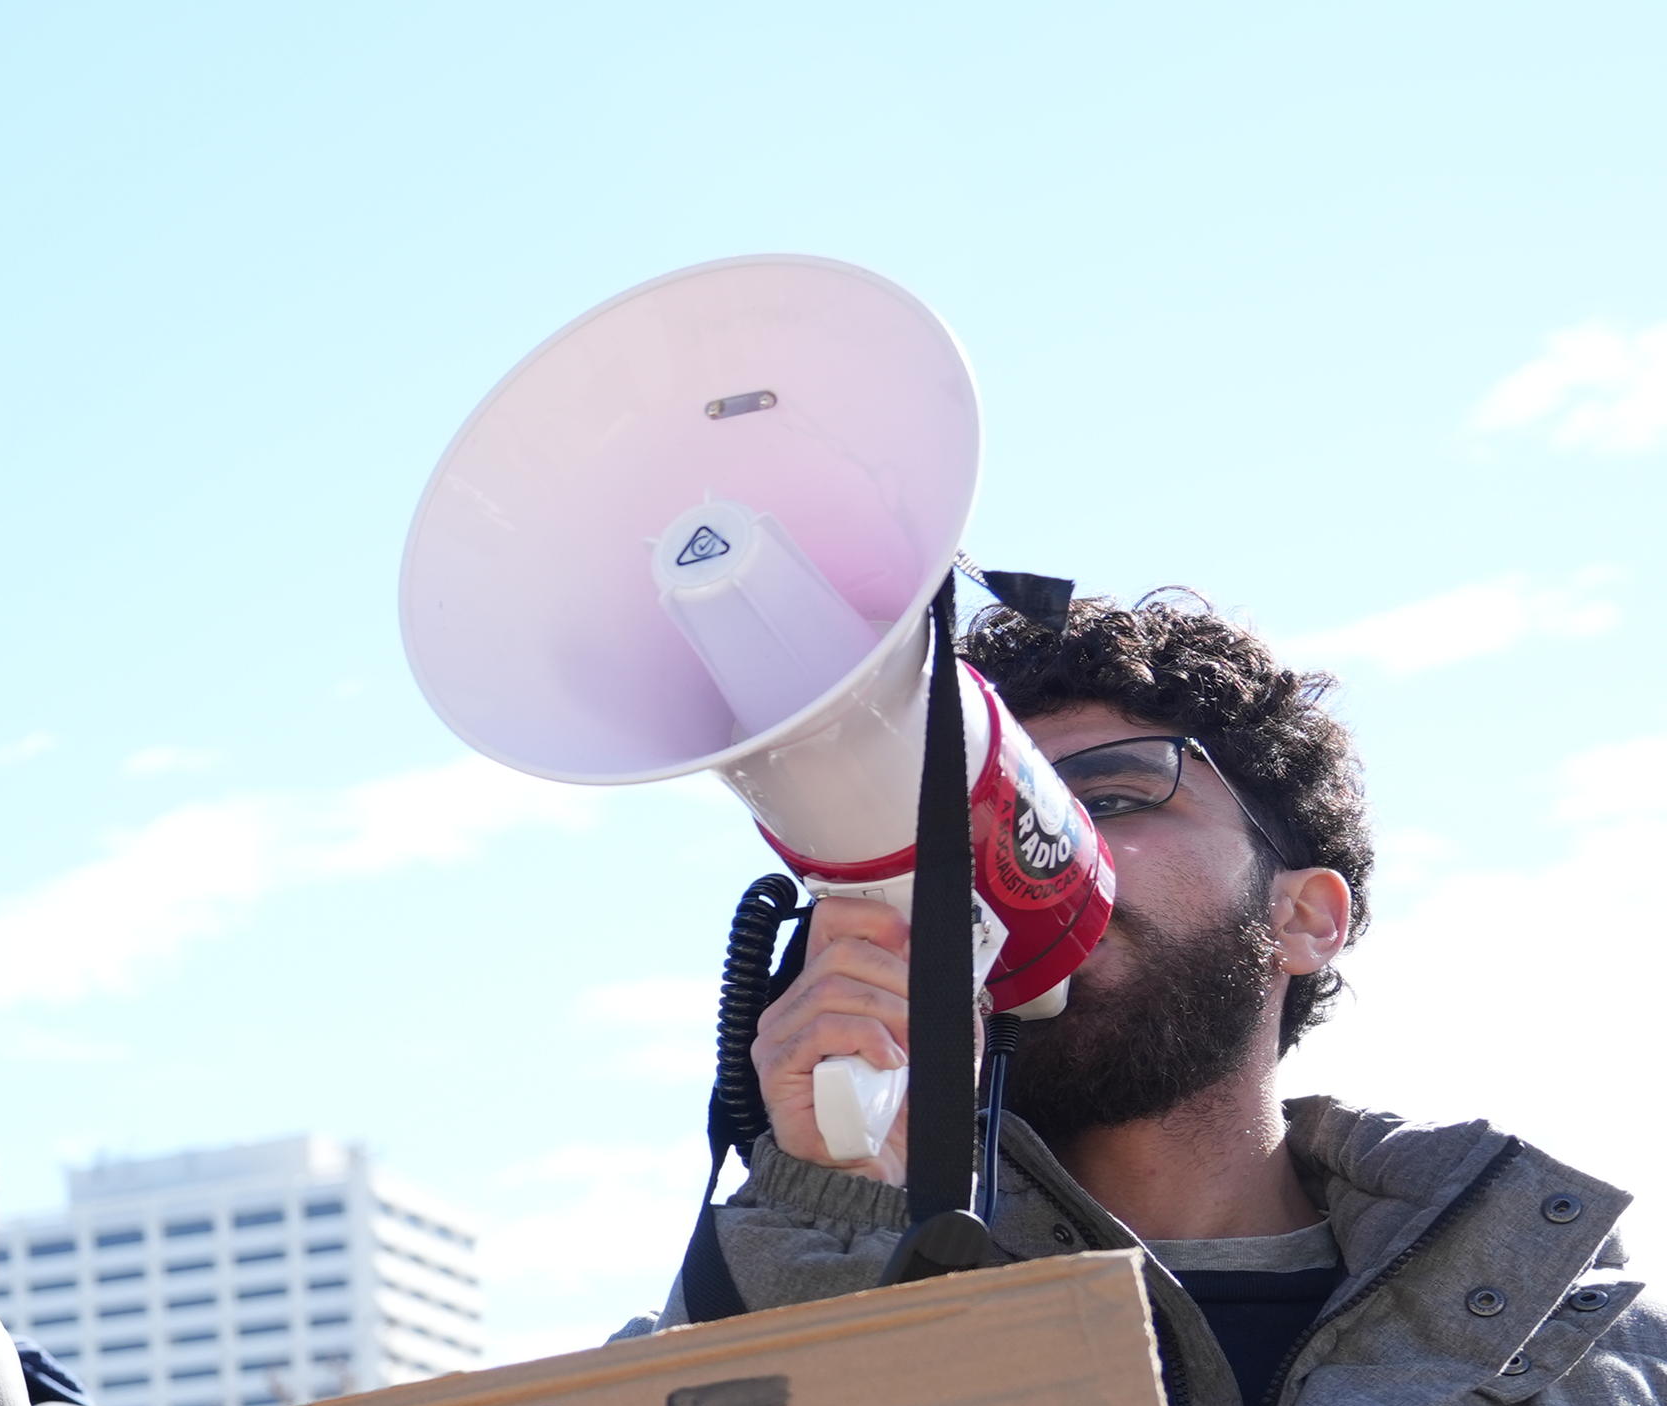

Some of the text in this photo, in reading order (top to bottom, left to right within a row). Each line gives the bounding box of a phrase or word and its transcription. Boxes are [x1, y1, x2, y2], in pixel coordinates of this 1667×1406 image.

[995, 817, 1026, 895] SOCIALIST
[1020, 860, 1082, 900] PODCAST
[1018, 807, 1071, 870] RADIO
